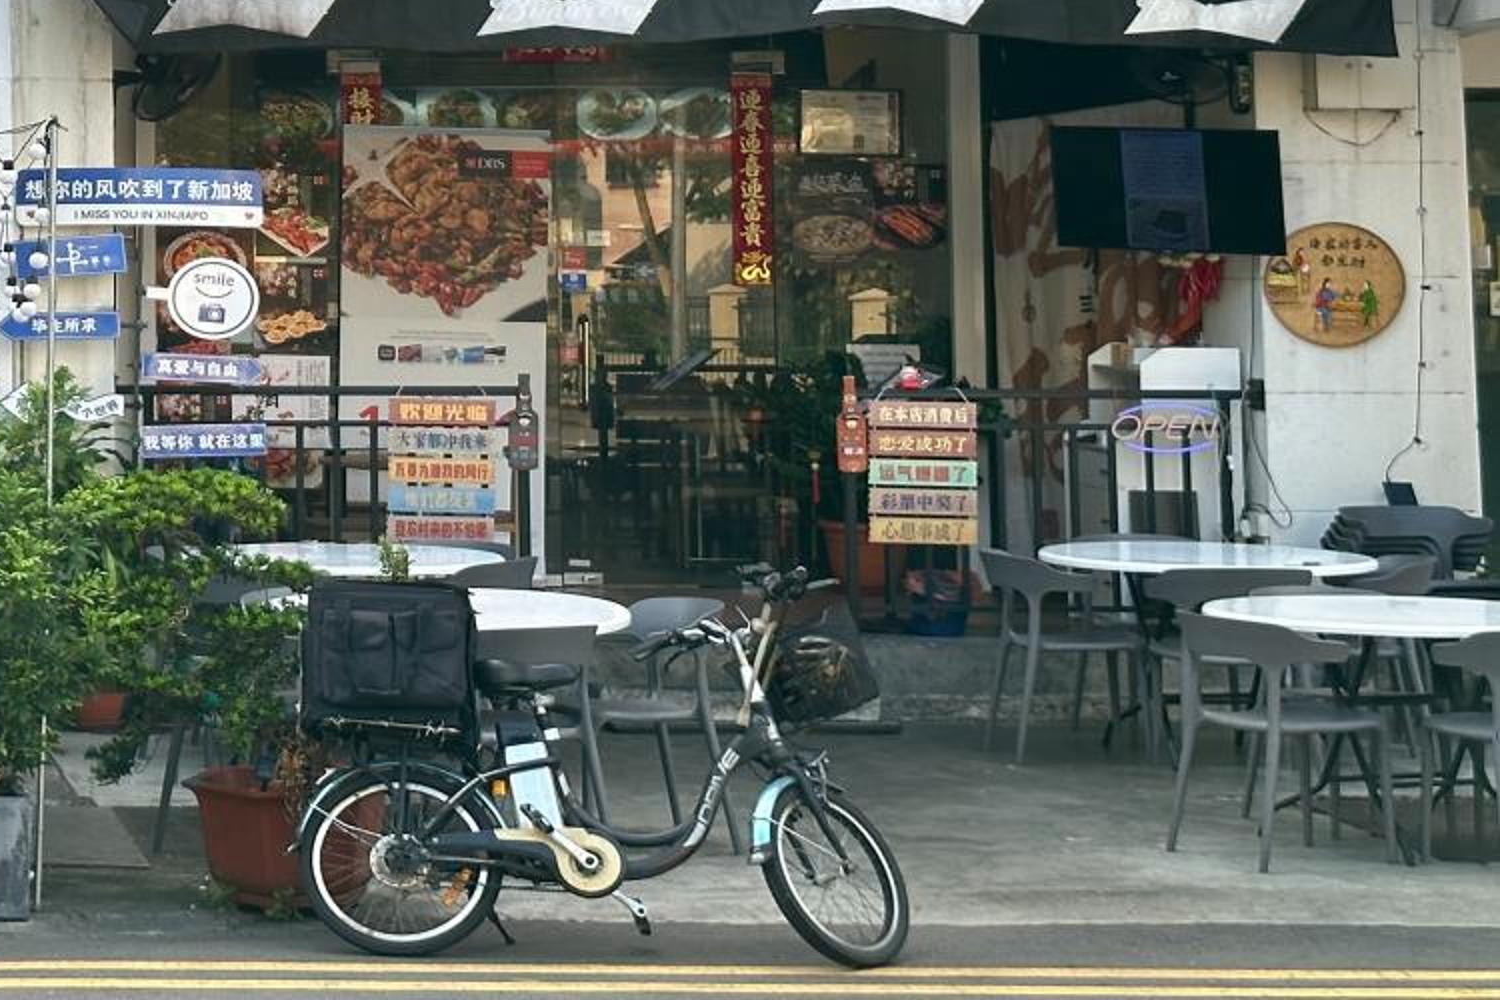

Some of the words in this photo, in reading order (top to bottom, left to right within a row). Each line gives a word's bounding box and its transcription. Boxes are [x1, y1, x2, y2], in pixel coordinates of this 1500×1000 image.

[81, 210, 110, 220] MISS
[112, 210, 140, 220] YOU
[142, 211, 154, 220] IN
[194, 272, 235, 287] smile
[399, 402, 487, 421] 欢迎光临
[879, 406, 968, 425] 在本店消费后
[1112, 415, 1220, 440] OPEN
